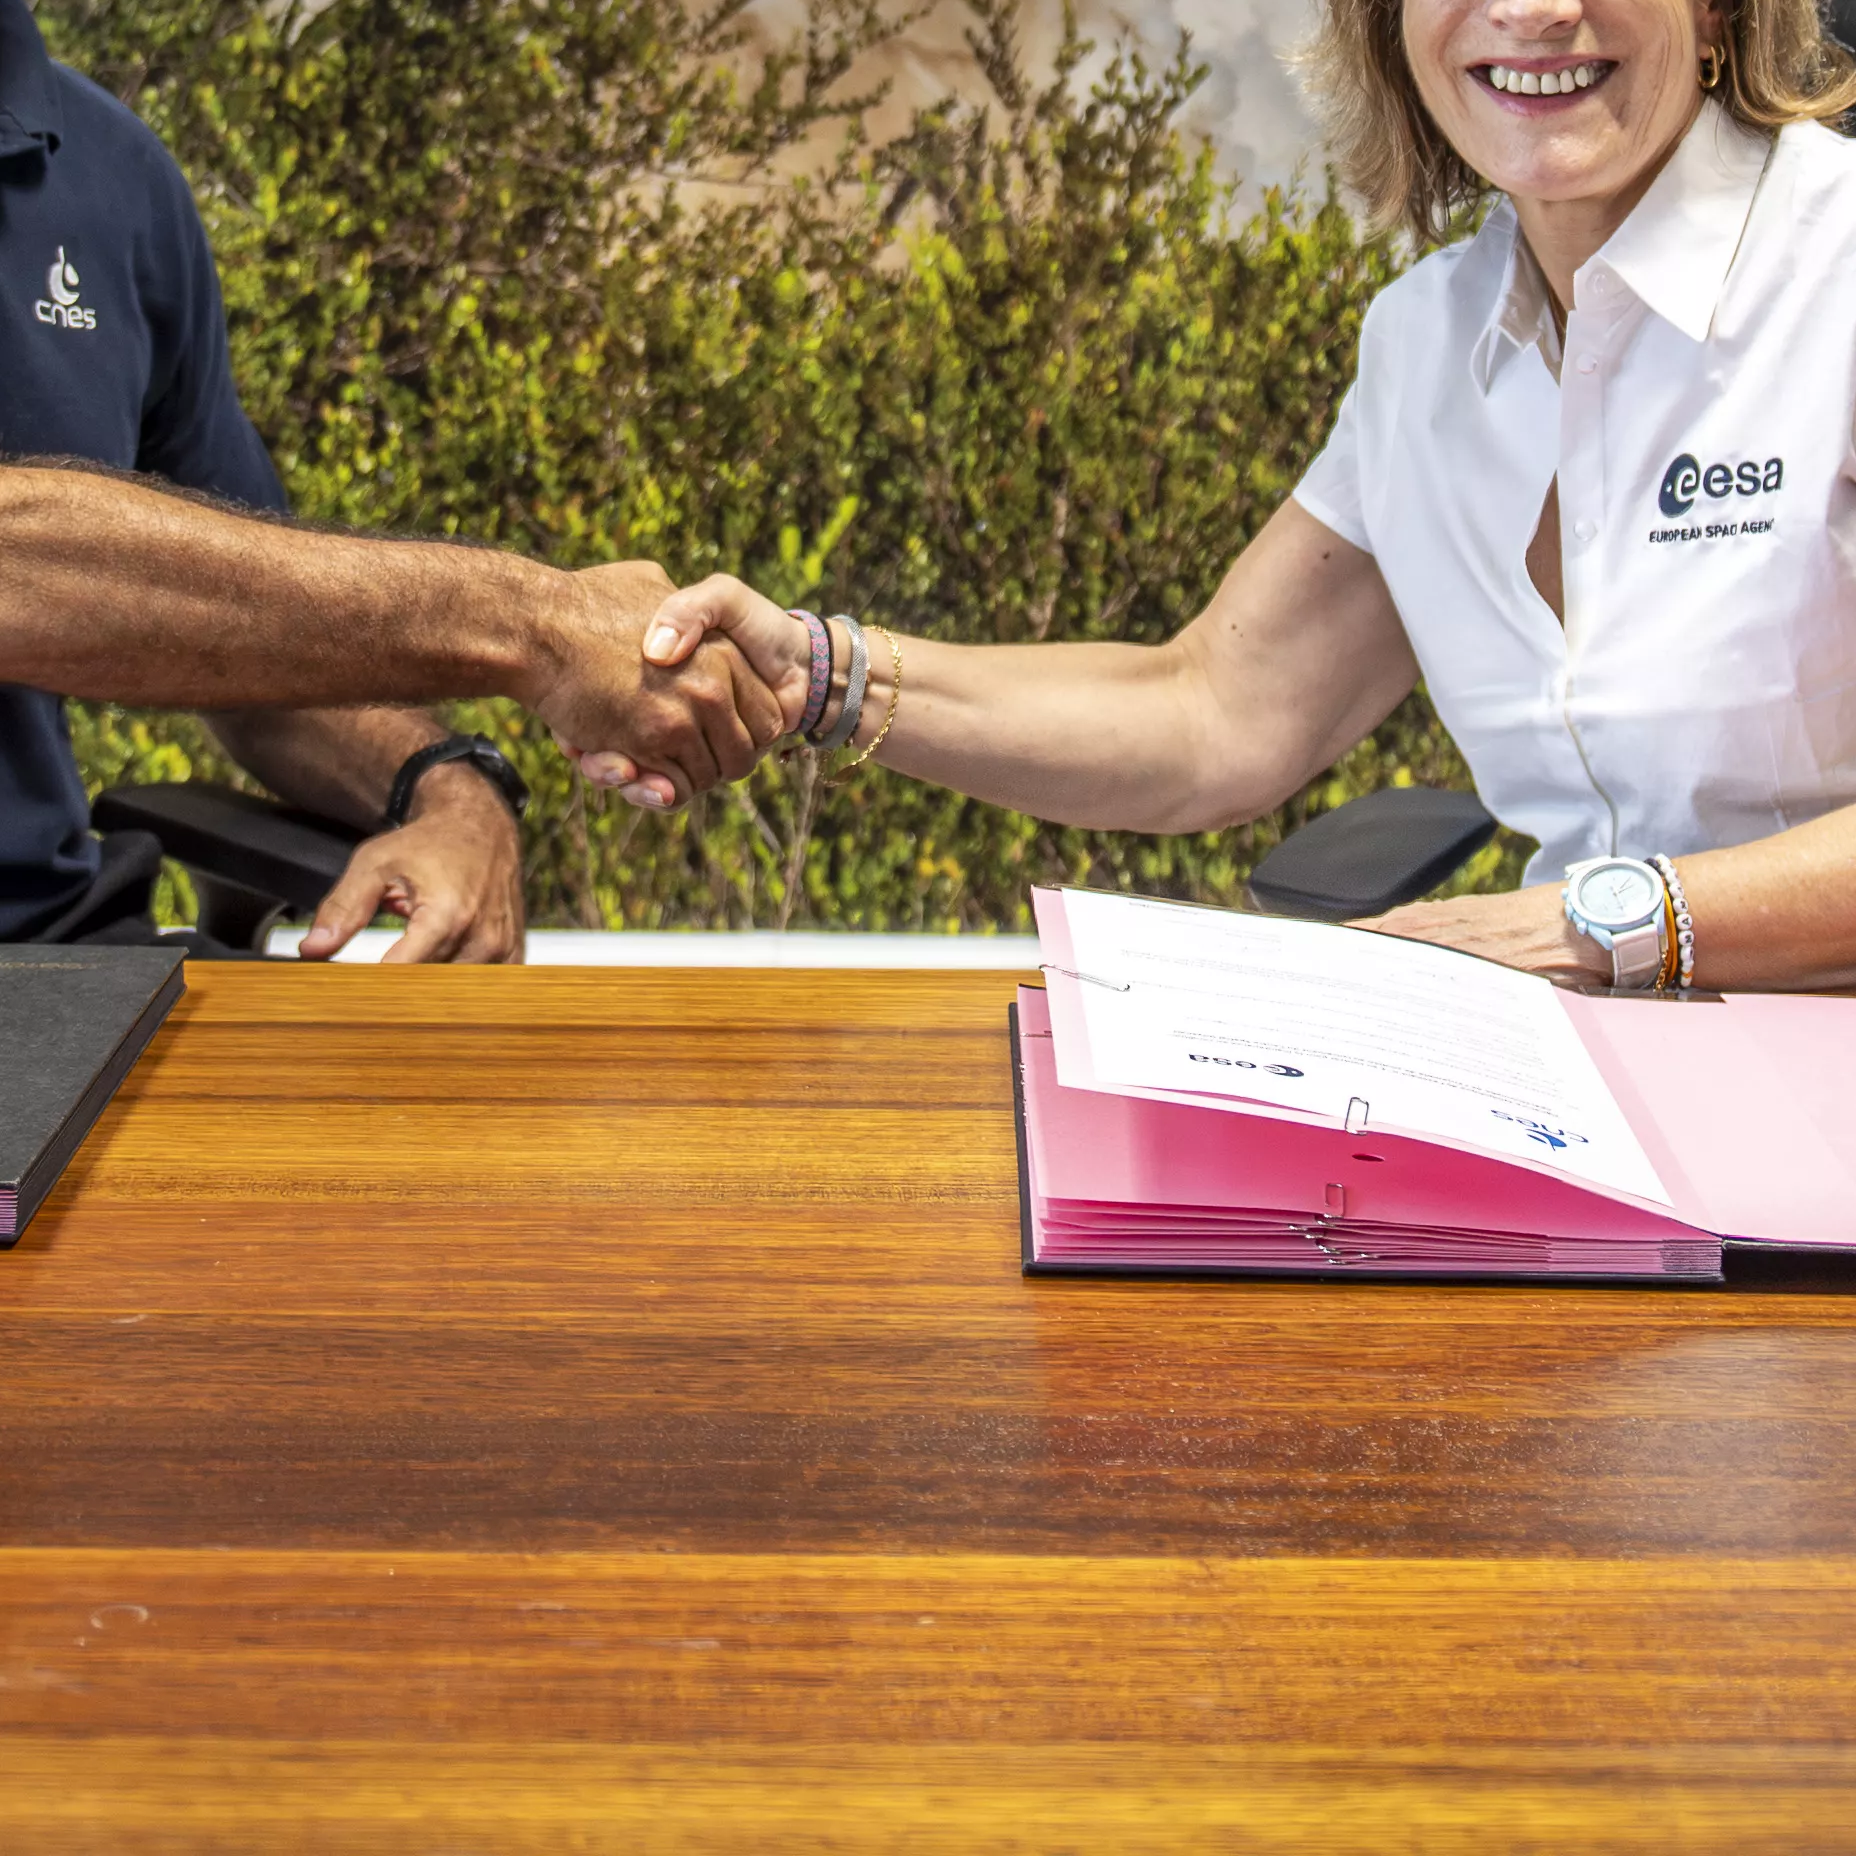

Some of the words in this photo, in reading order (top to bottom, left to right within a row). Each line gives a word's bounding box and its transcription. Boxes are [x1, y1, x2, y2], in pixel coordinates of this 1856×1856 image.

[34, 298, 98, 331] cnes
[1702, 456, 1784, 500] esa
[1490, 1108, 1590, 1144] cnes
